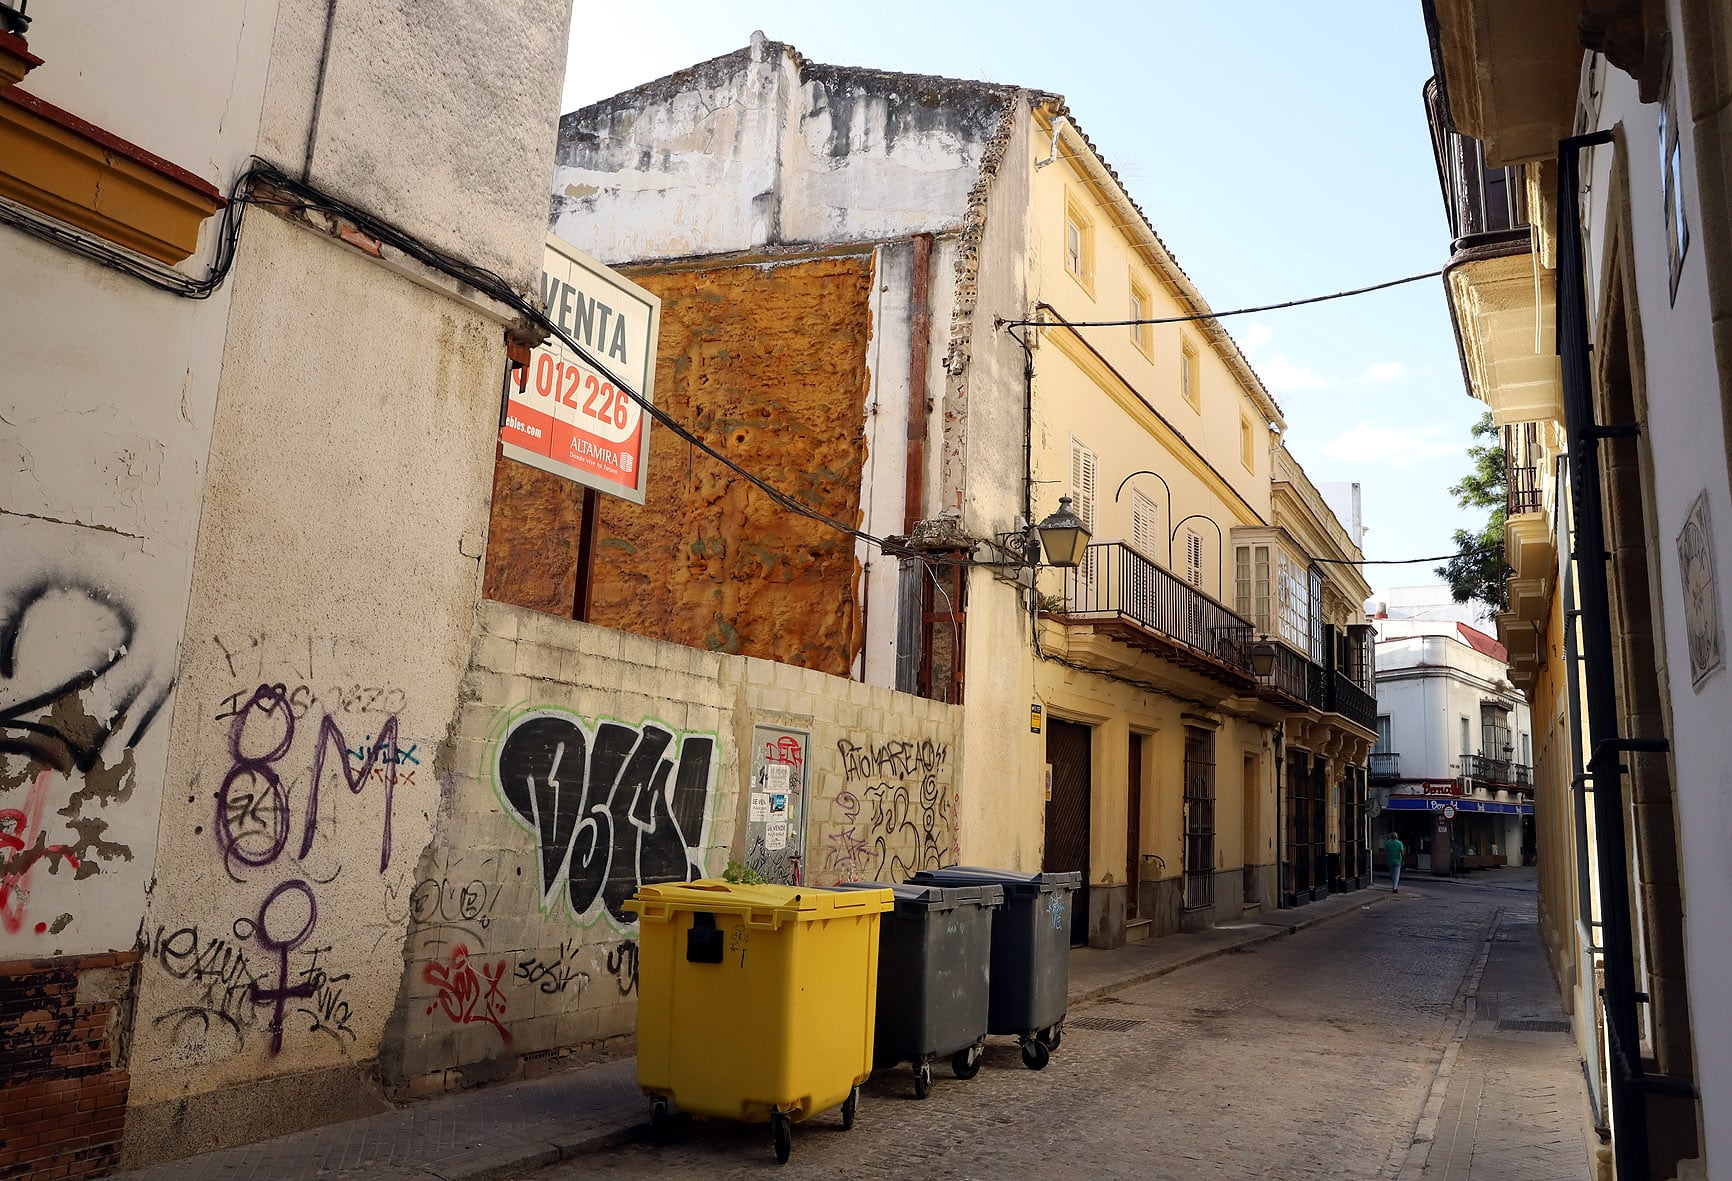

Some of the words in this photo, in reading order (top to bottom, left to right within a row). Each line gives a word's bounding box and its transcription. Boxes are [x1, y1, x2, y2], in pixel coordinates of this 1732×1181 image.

[541, 271, 626, 365] VENTA
[536, 353, 580, 410] 012
[582, 375, 628, 430] 226
[570, 436, 618, 467] ALTAMIRA
